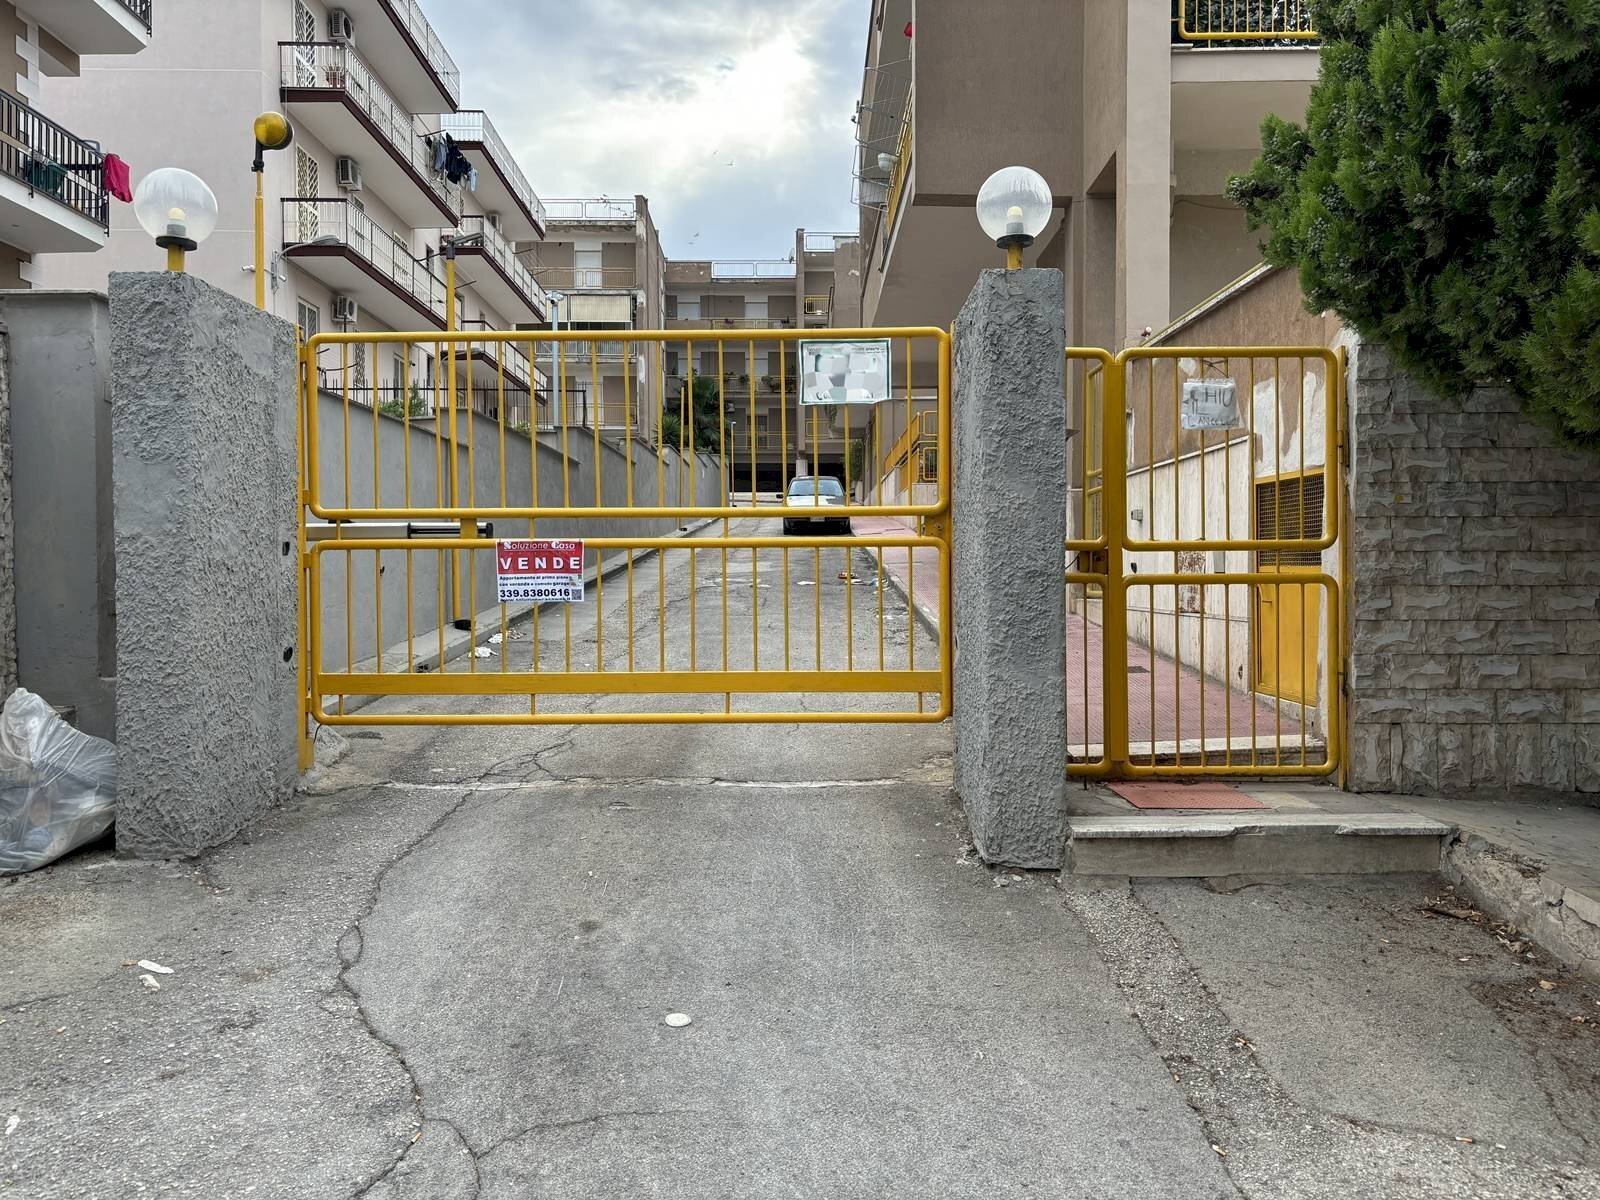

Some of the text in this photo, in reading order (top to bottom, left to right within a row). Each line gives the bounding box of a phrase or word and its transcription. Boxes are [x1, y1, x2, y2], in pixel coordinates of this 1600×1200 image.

[503, 540, 575, 550] Soluzione Casa
[499, 557, 581, 570] VENDE
[500, 588, 570, 598] 339.8380616
